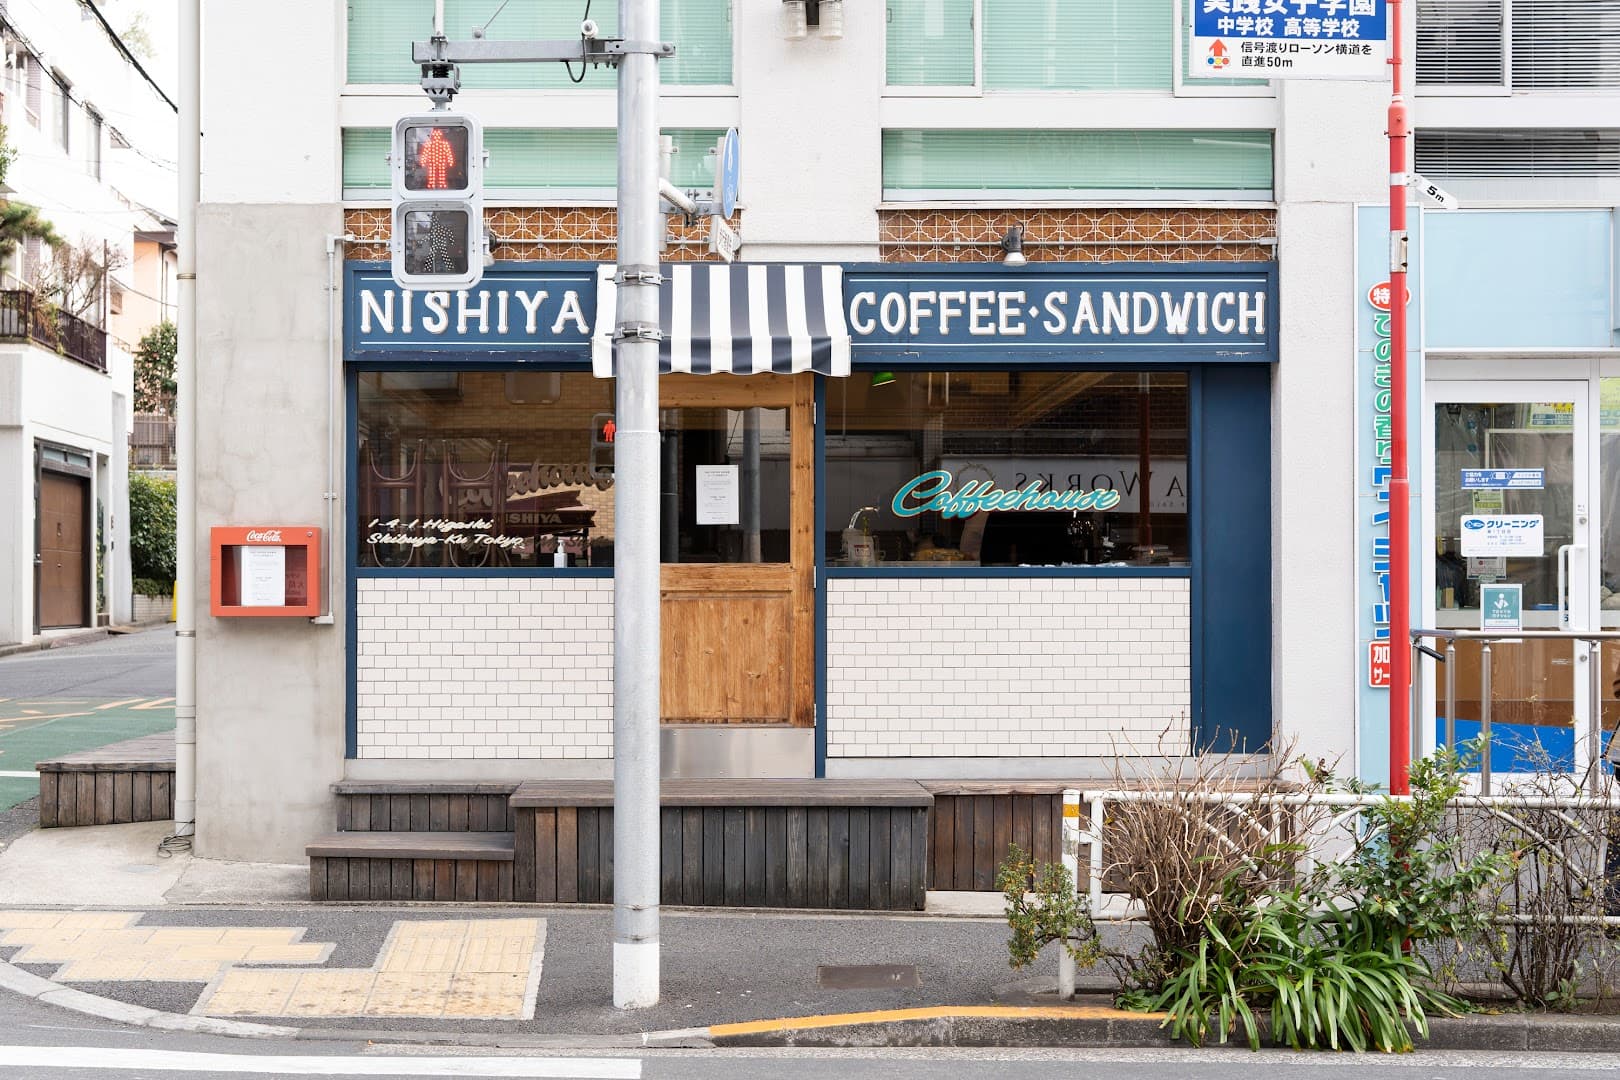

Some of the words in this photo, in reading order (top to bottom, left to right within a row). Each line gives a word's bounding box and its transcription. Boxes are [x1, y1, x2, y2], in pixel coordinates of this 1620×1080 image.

[1217, 17, 1274, 36] 中学校
[1284, 18, 1360, 38] 高等学校
[1241, 41, 1372, 56] 信号渡りローソン横道を
[1241, 57, 1293, 68] 直進50m
[360, 289, 590, 335] NISHIYA
[891, 470, 1121, 519] Coffeehouse
[422, 518, 493, 533] Higashi
[1486, 519, 1540, 528] クリーニング
